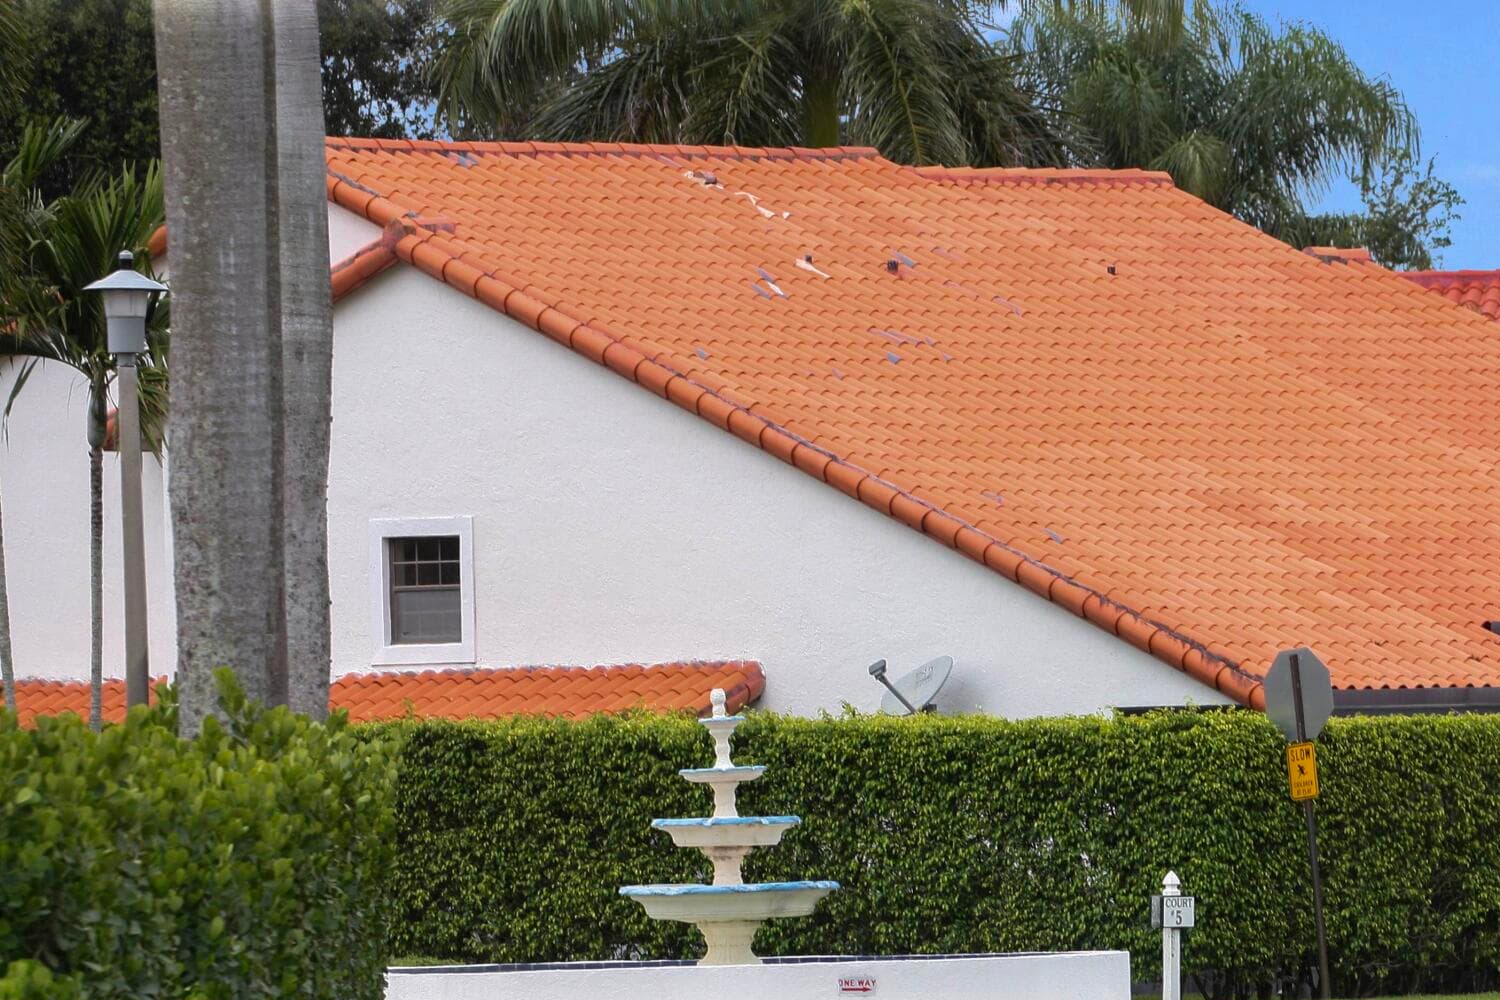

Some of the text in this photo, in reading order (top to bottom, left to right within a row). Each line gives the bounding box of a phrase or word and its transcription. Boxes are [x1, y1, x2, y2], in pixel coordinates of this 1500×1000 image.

[1290, 748, 1311, 762] SLOW
[1165, 898, 1193, 908] COURT
[838, 978, 876, 987] ONE WAY
